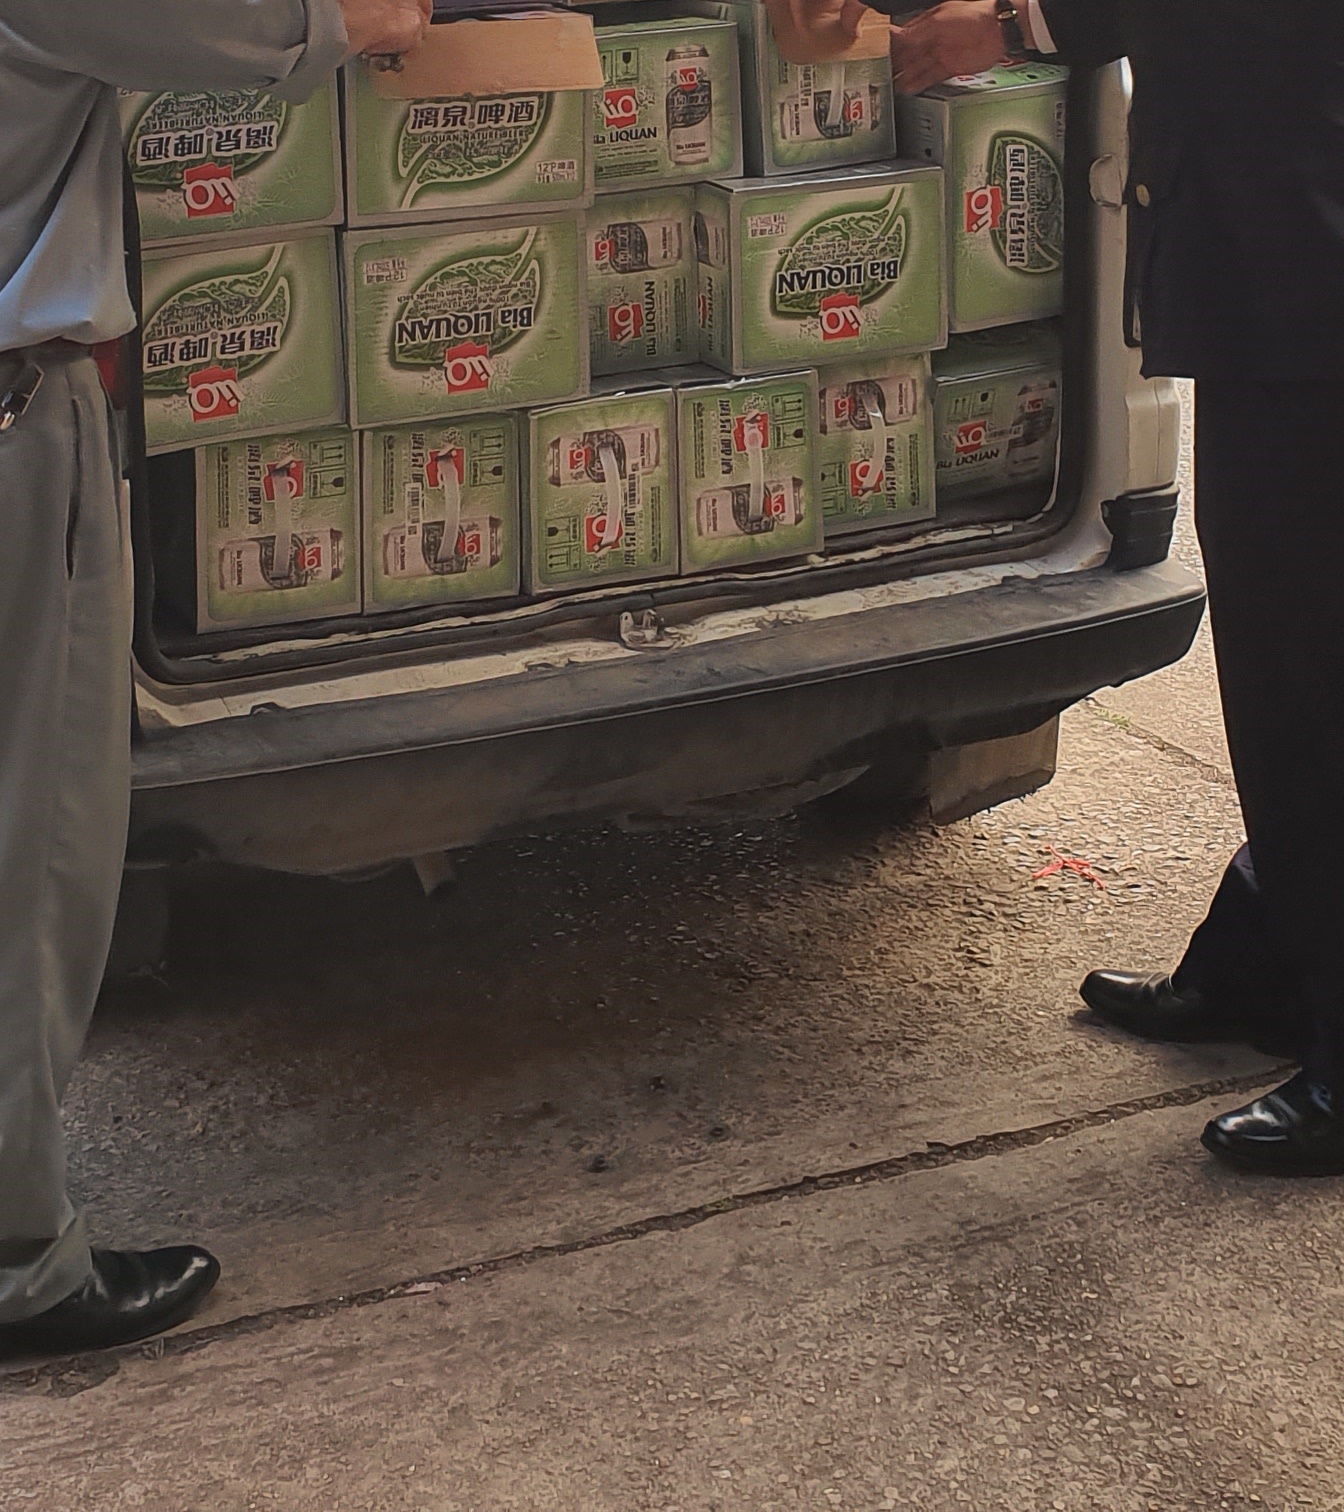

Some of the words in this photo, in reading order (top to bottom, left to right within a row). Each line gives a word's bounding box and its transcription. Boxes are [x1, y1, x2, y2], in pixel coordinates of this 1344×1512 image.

[411, 100, 536, 130] 漓泉啤酒
[610, 127, 657, 142] LIQUAN
[778, 264, 862, 293] LIQUAN
[869, 259, 898, 280] Bia
[501, 306, 532, 328] Bia
[644, 281, 656, 333] LIQUAN
[397, 311, 492, 343] LIQUAN
